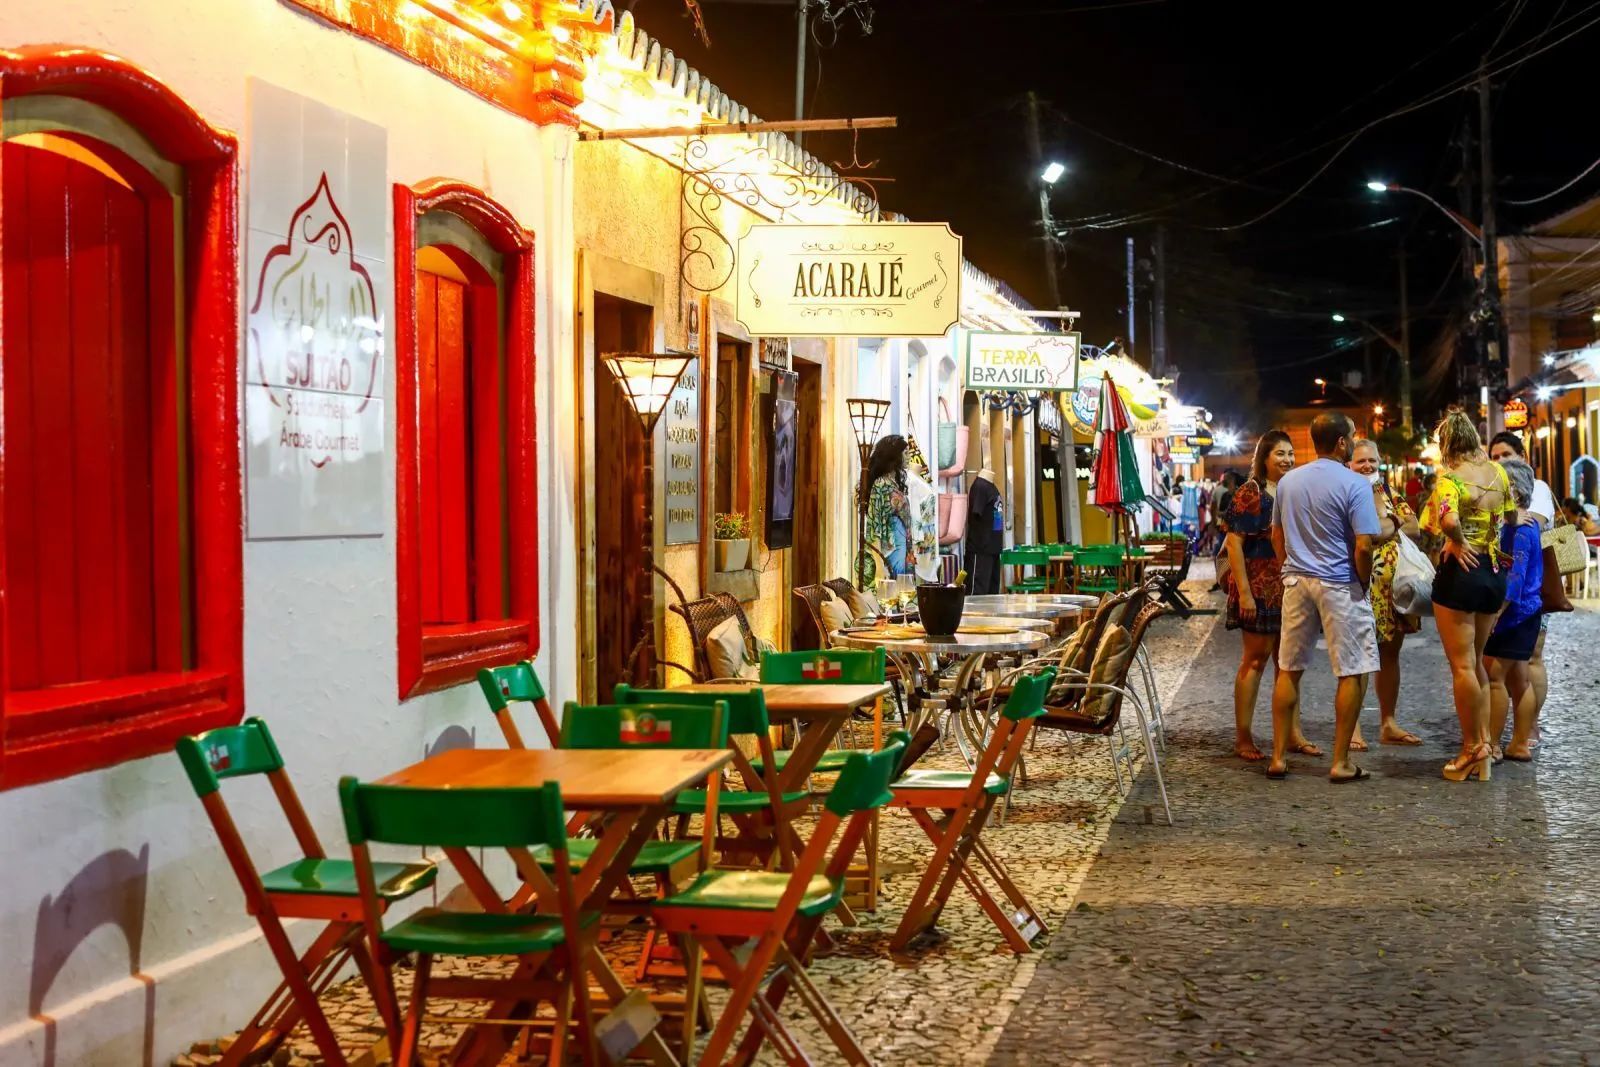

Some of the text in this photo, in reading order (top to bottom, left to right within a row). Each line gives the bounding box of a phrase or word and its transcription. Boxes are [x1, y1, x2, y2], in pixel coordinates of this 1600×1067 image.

[793, 257, 939, 300] ACARAJÉ Gourmet
[286, 350, 352, 391] SULTÃO
[979, 349, 1042, 366] TERRA
[972, 367, 1046, 384] BRASILIS
[280, 421, 360, 450] Árabe Gourmet
